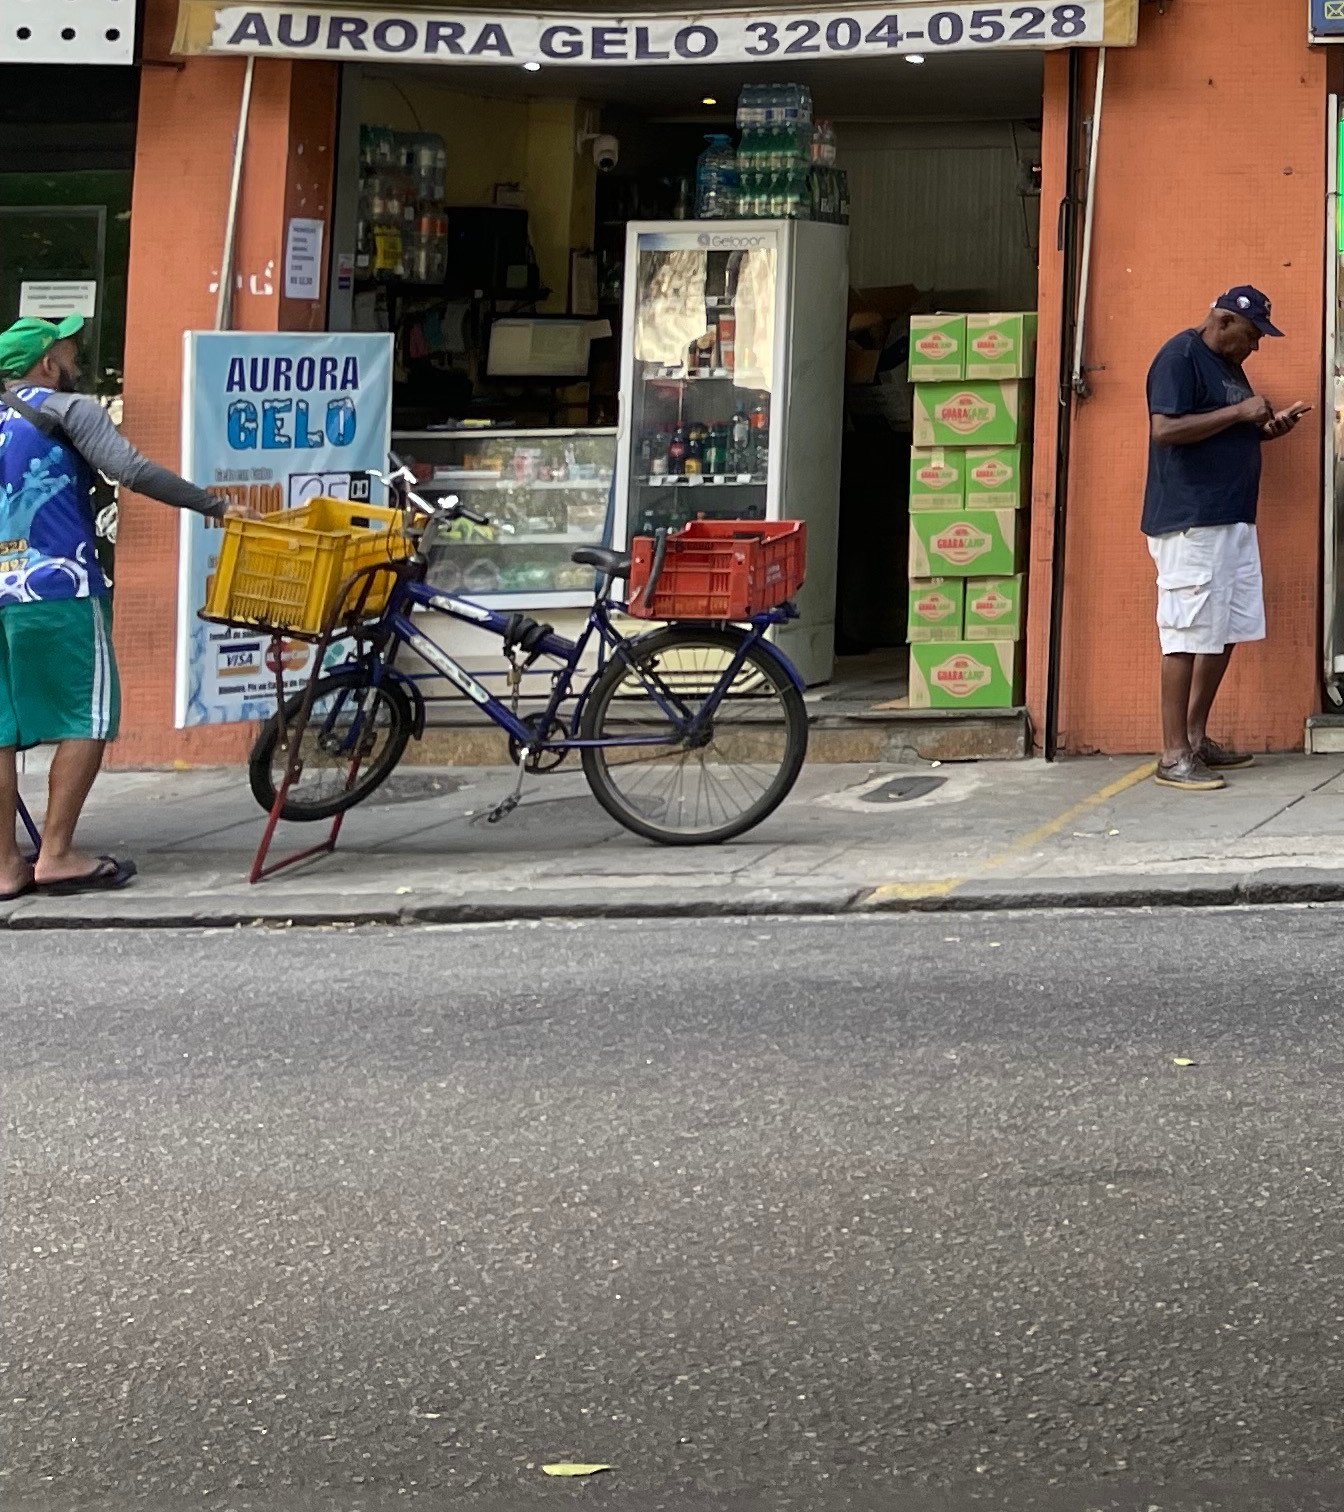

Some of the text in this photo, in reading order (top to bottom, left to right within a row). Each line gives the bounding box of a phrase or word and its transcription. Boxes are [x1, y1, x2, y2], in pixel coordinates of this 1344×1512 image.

[228, 4, 1086, 59] AURORA GELO 3204-0528
[226, 356, 359, 393] AURORA
[227, 397, 357, 450] GELO
[226, 653, 253, 667] VISA
